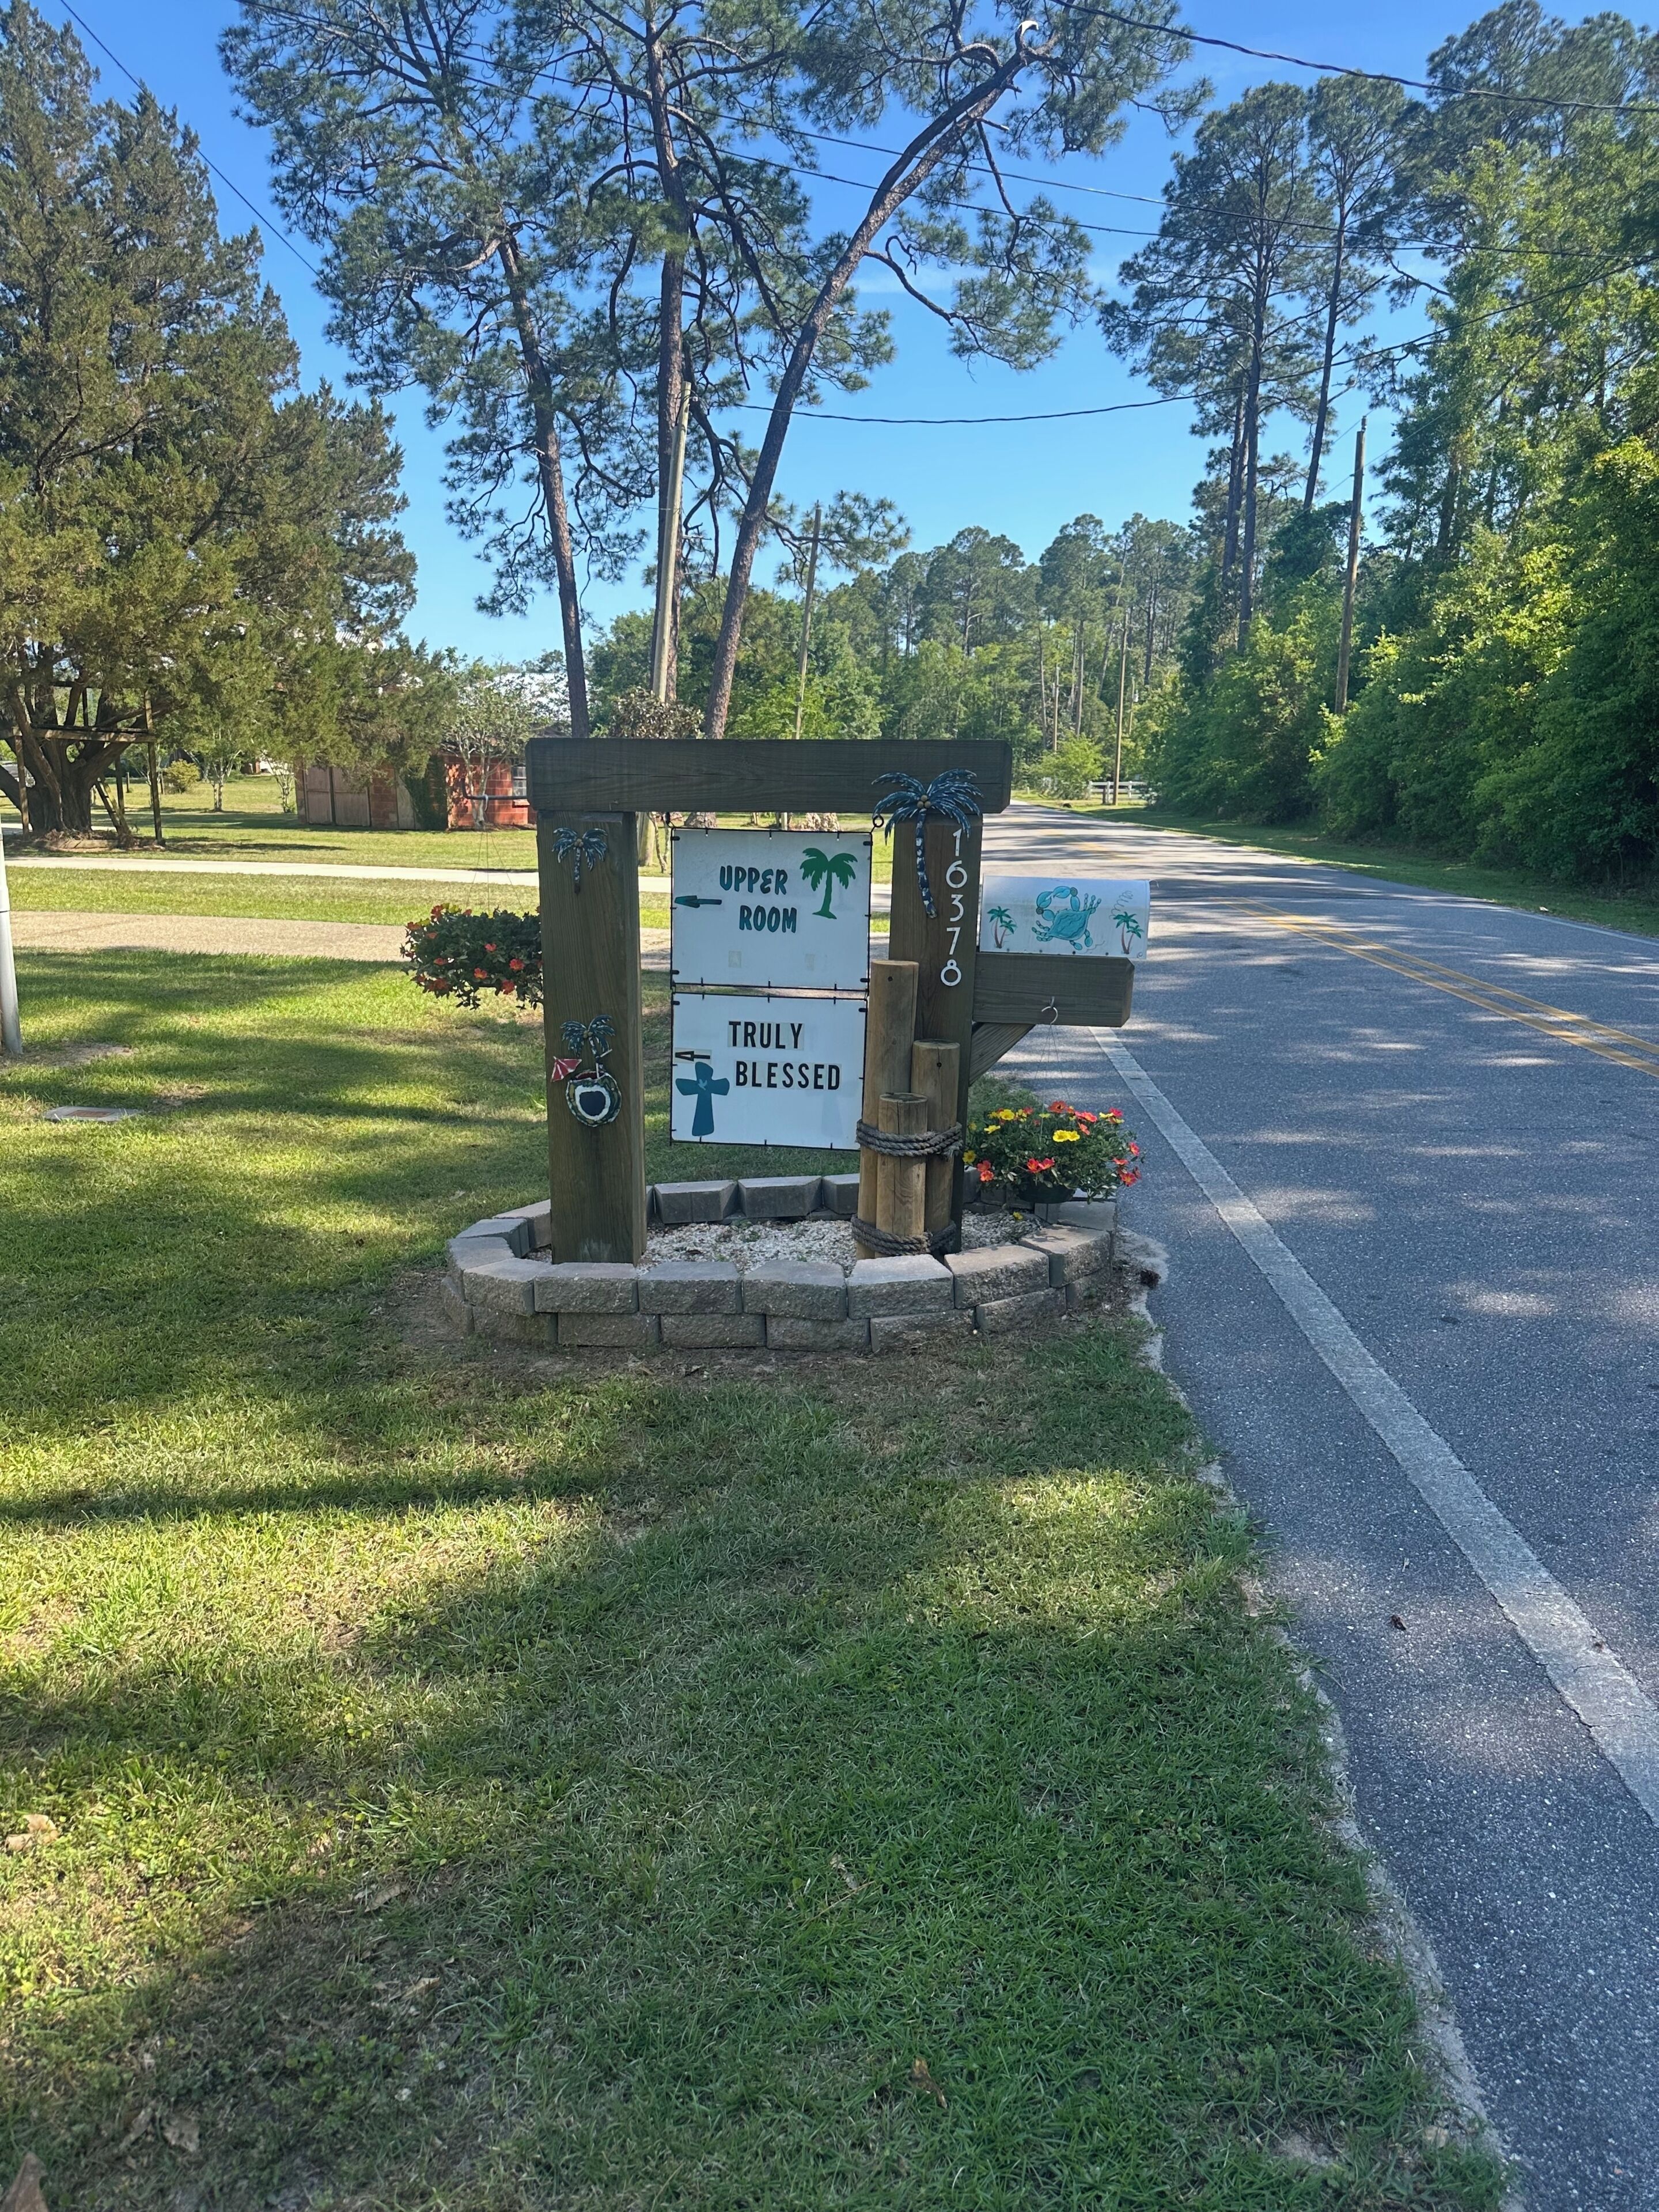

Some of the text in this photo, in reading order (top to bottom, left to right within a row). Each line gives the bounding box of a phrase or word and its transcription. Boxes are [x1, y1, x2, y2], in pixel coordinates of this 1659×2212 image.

[719, 865, 788, 895] UPPER
[739, 905, 797, 933] ROOM
[940, 828, 967, 987] 16378
[729, 1021, 803, 1049] TRULY
[736, 1060, 840, 1090] BLESSED
